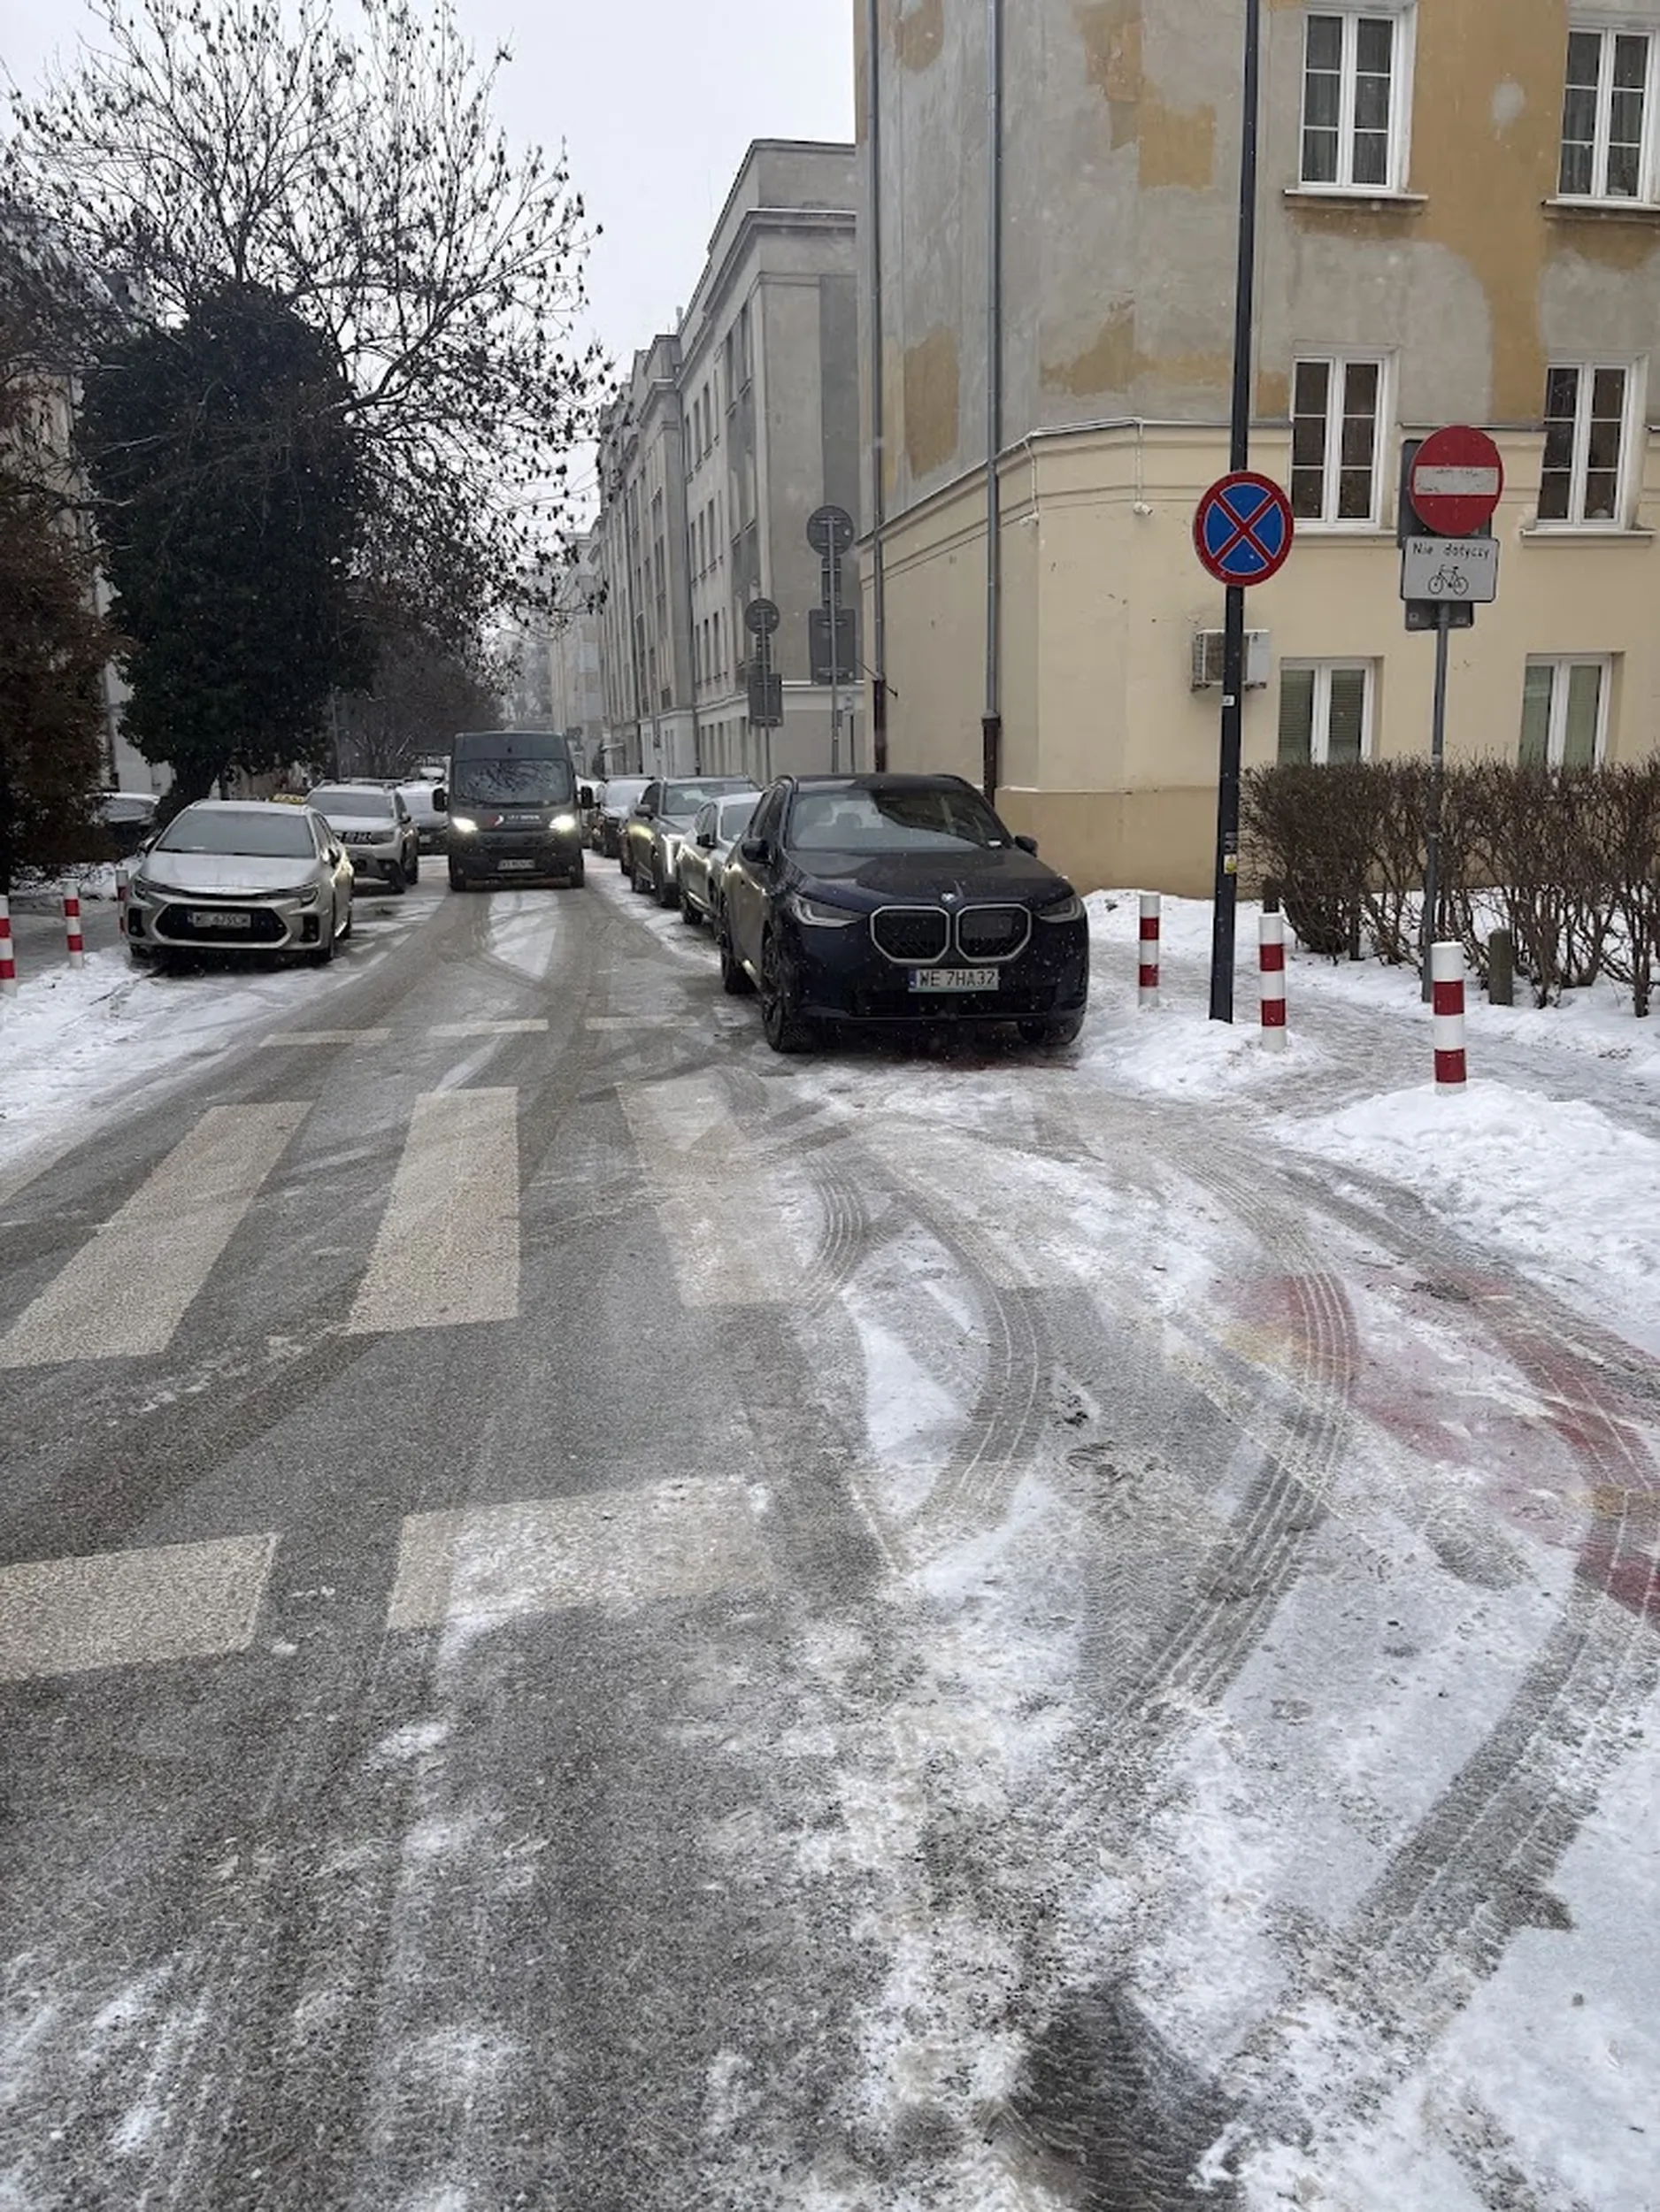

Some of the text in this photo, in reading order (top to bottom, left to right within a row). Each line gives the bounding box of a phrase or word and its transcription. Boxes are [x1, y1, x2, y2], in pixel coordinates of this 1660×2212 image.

[1413, 542, 1489, 559] Nie dotyczy
[920, 971, 940, 987] WE
